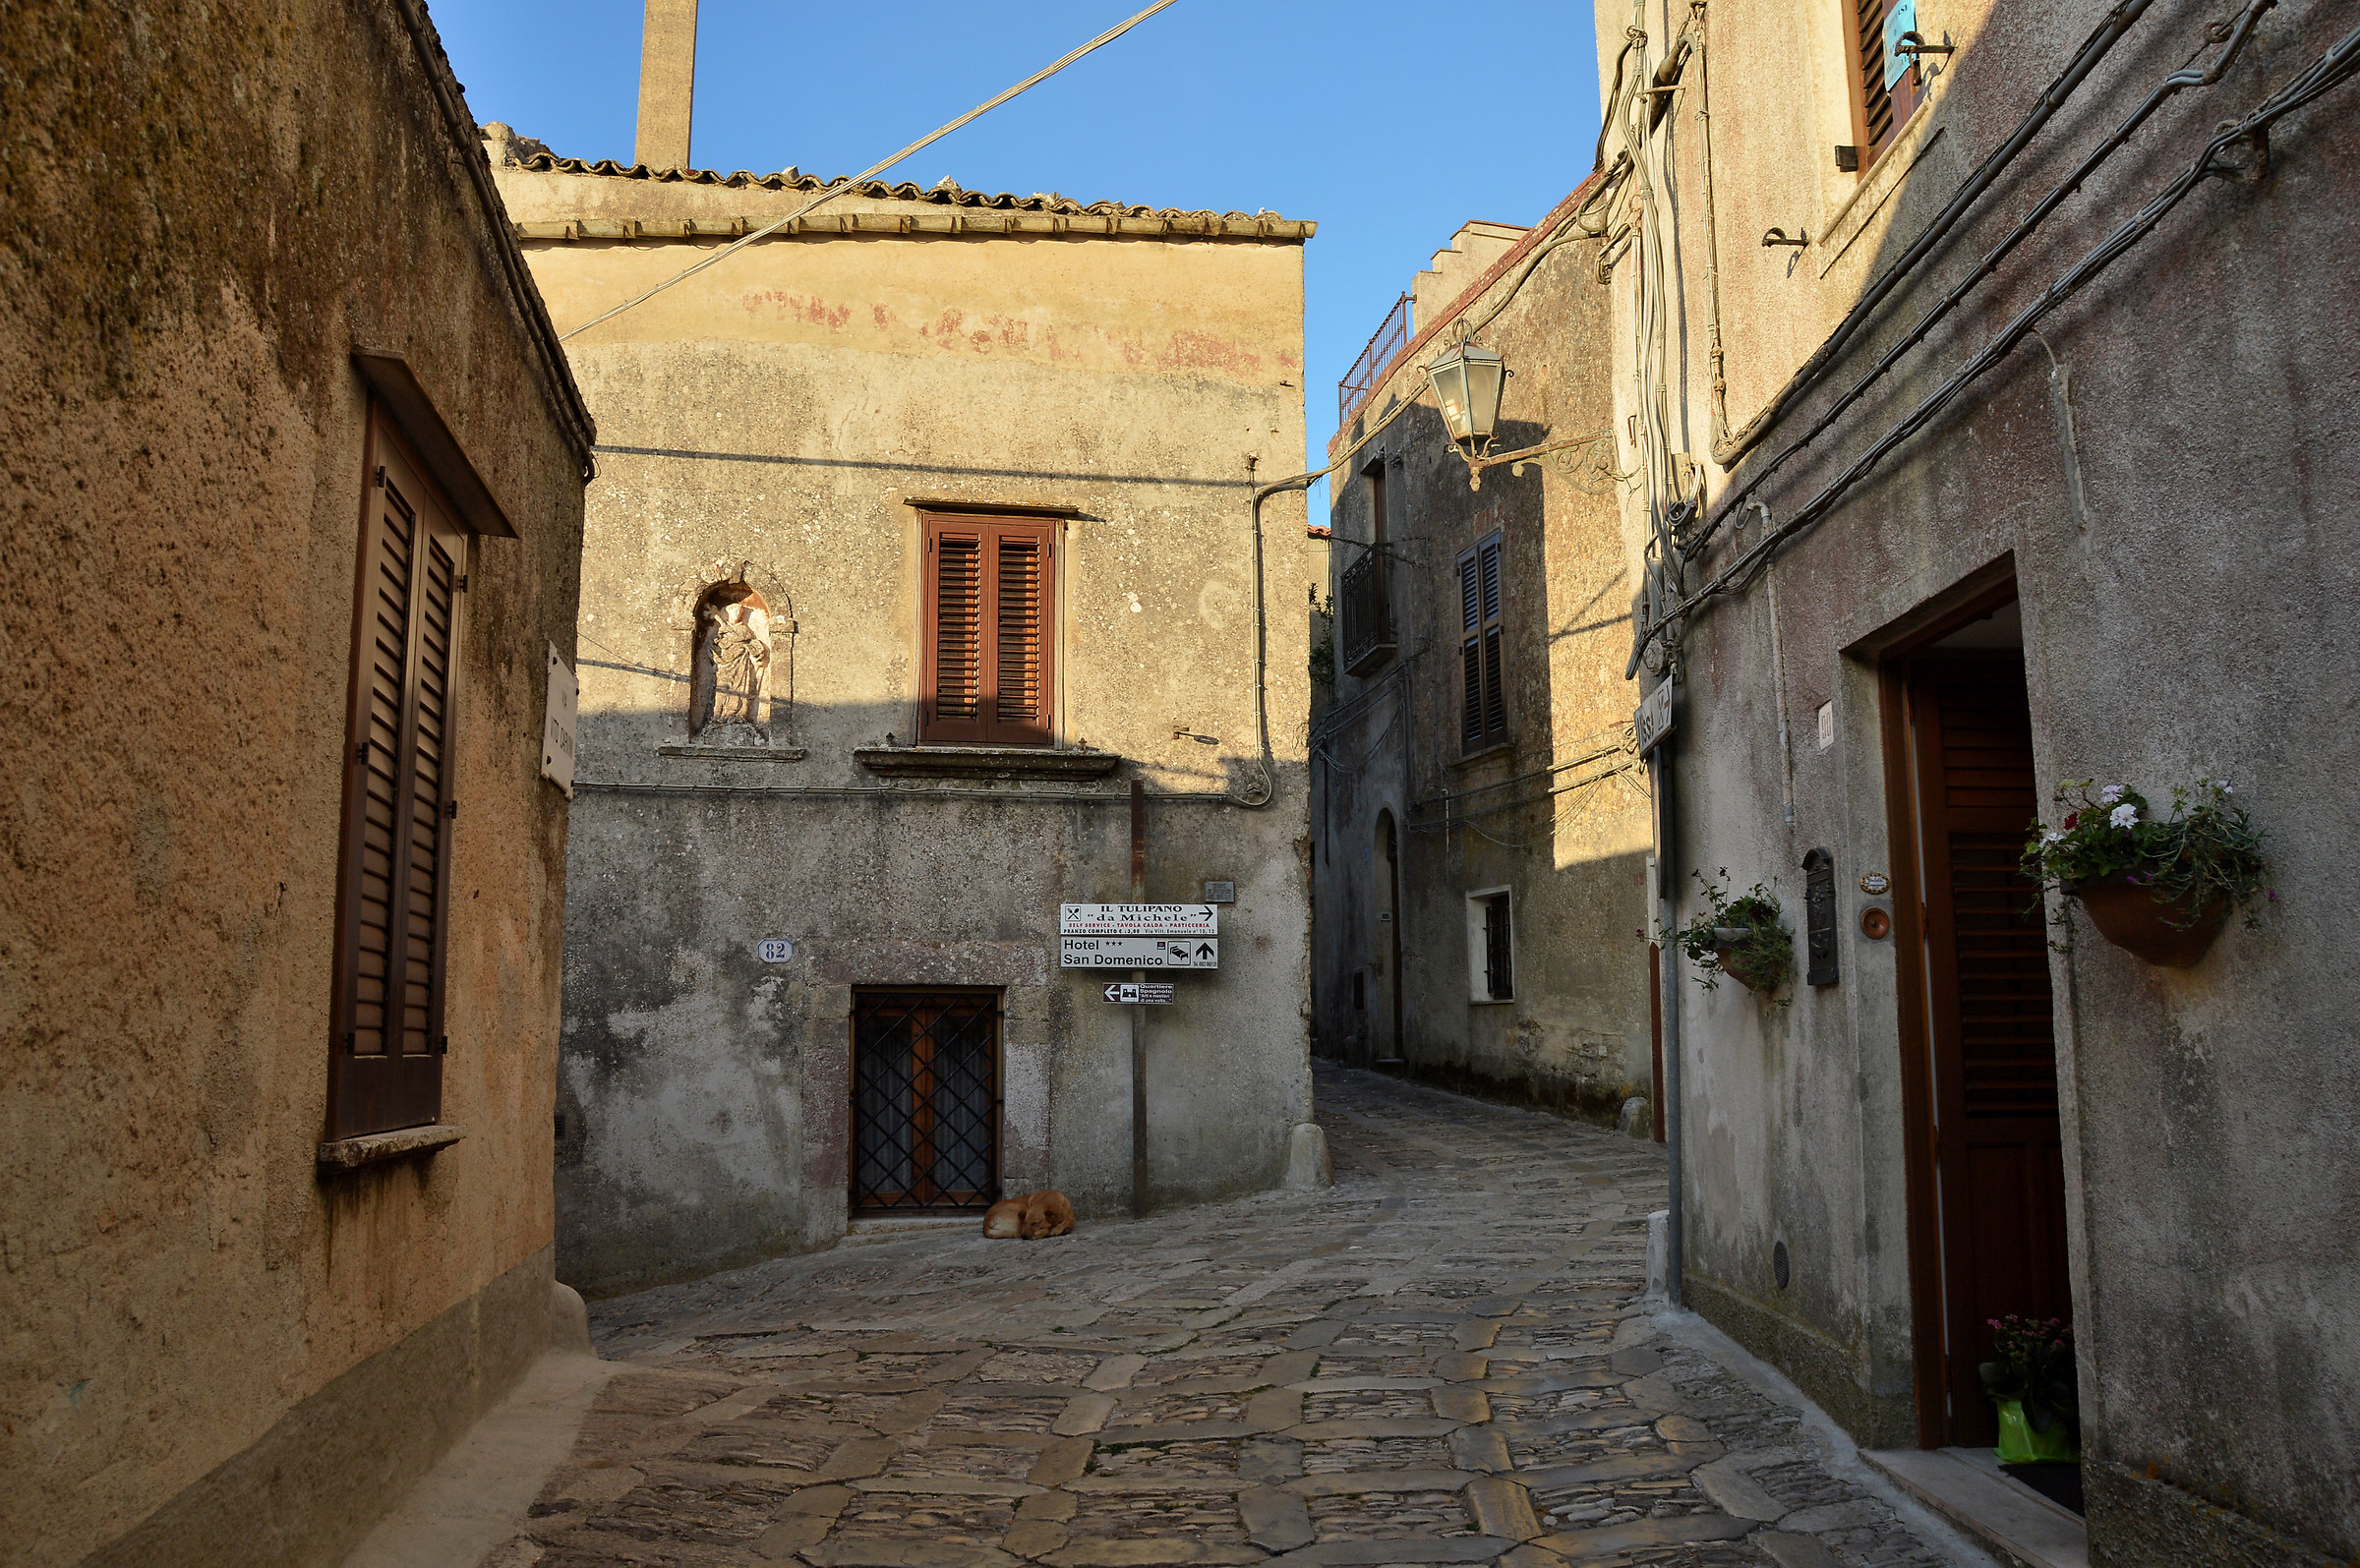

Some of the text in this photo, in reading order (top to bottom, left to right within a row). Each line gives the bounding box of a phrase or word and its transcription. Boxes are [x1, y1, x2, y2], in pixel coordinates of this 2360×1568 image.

[765, 942, 786, 959] 82
[1064, 939, 1099, 951] Hotel
[1064, 954, 1163, 965] San Domenico
